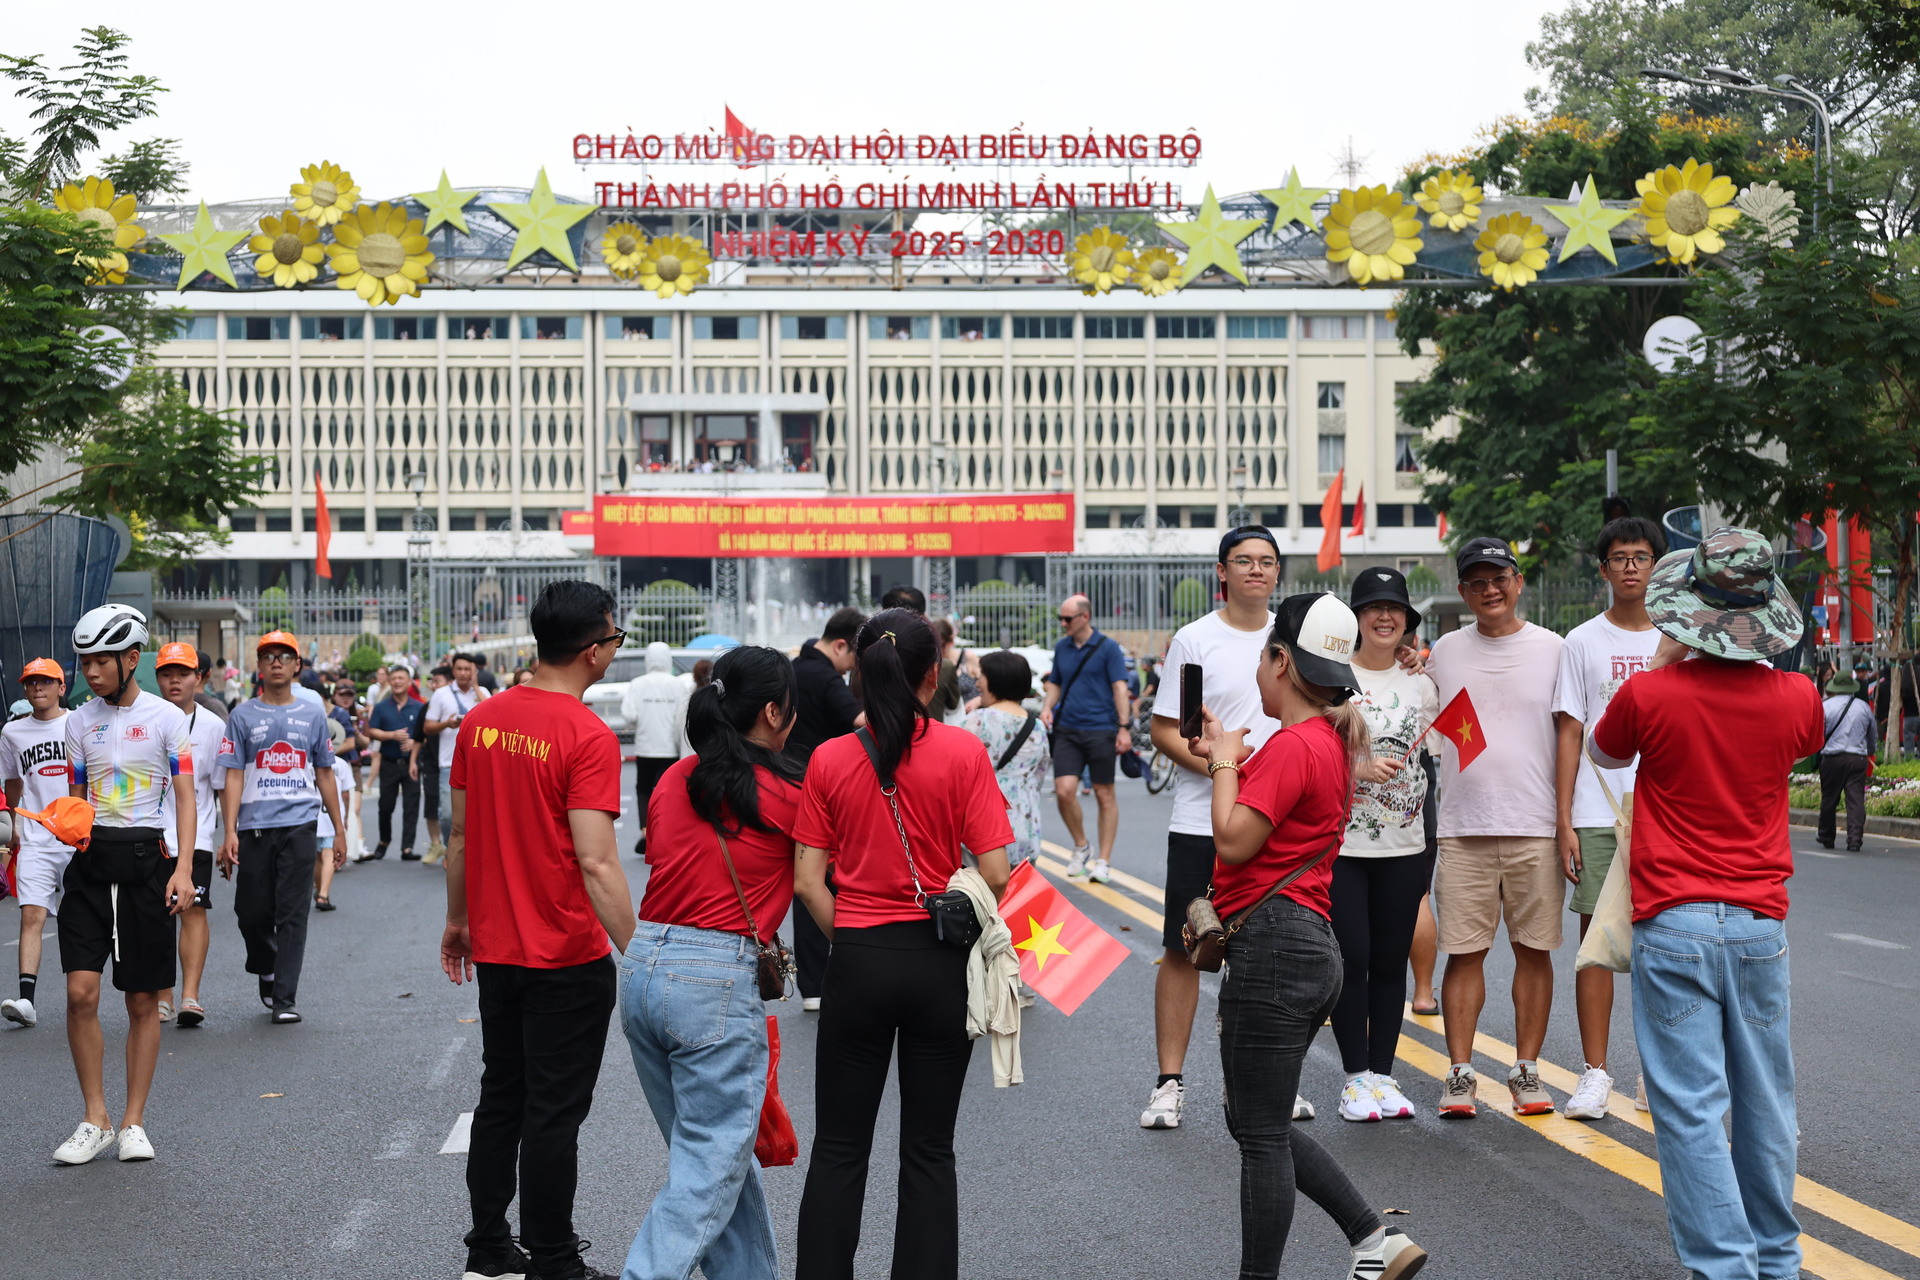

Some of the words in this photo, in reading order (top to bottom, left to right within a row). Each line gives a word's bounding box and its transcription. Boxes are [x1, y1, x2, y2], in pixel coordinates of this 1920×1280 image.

[573, 125, 663, 160] CHÀO
[787, 134, 839, 165] ĐẠI
[852, 128, 903, 166] HỘI
[916, 134, 968, 165] ĐẠI
[979, 121, 1048, 159] BIỂU
[1058, 126, 1149, 160] ĐẢNG
[1158, 126, 1202, 165] BỘ
[595, 174, 710, 208] THÀNH
[722, 173, 788, 208] PHỐ
[800, 174, 844, 208] HỒ
[856, 175, 910, 208] CHÍ
[918, 182, 1001, 208] MINH
[1010, 172, 1075, 208] LẦN
[1087, 175, 1158, 208] THỨ
[714, 224, 816, 262] NHIỆM
[826, 224, 870, 257] KỲ
[890, 231, 966, 257] 2025
[988, 229, 1065, 256] 2030
[603, 501, 628, 527] NHIỆT
[628, 501, 646, 527] LIỆT
[647, 502, 670, 524] CHÀO
[765, 503, 788, 524] NGÀY
[719, 530, 731, 551] VÀ
[770, 530, 792, 551] NGÀY
[262, 749, 301, 766] Alpecin
[472, 726, 482, 747] I
[501, 728, 526, 757] VIỆT
[523, 735, 551, 762] NAM
